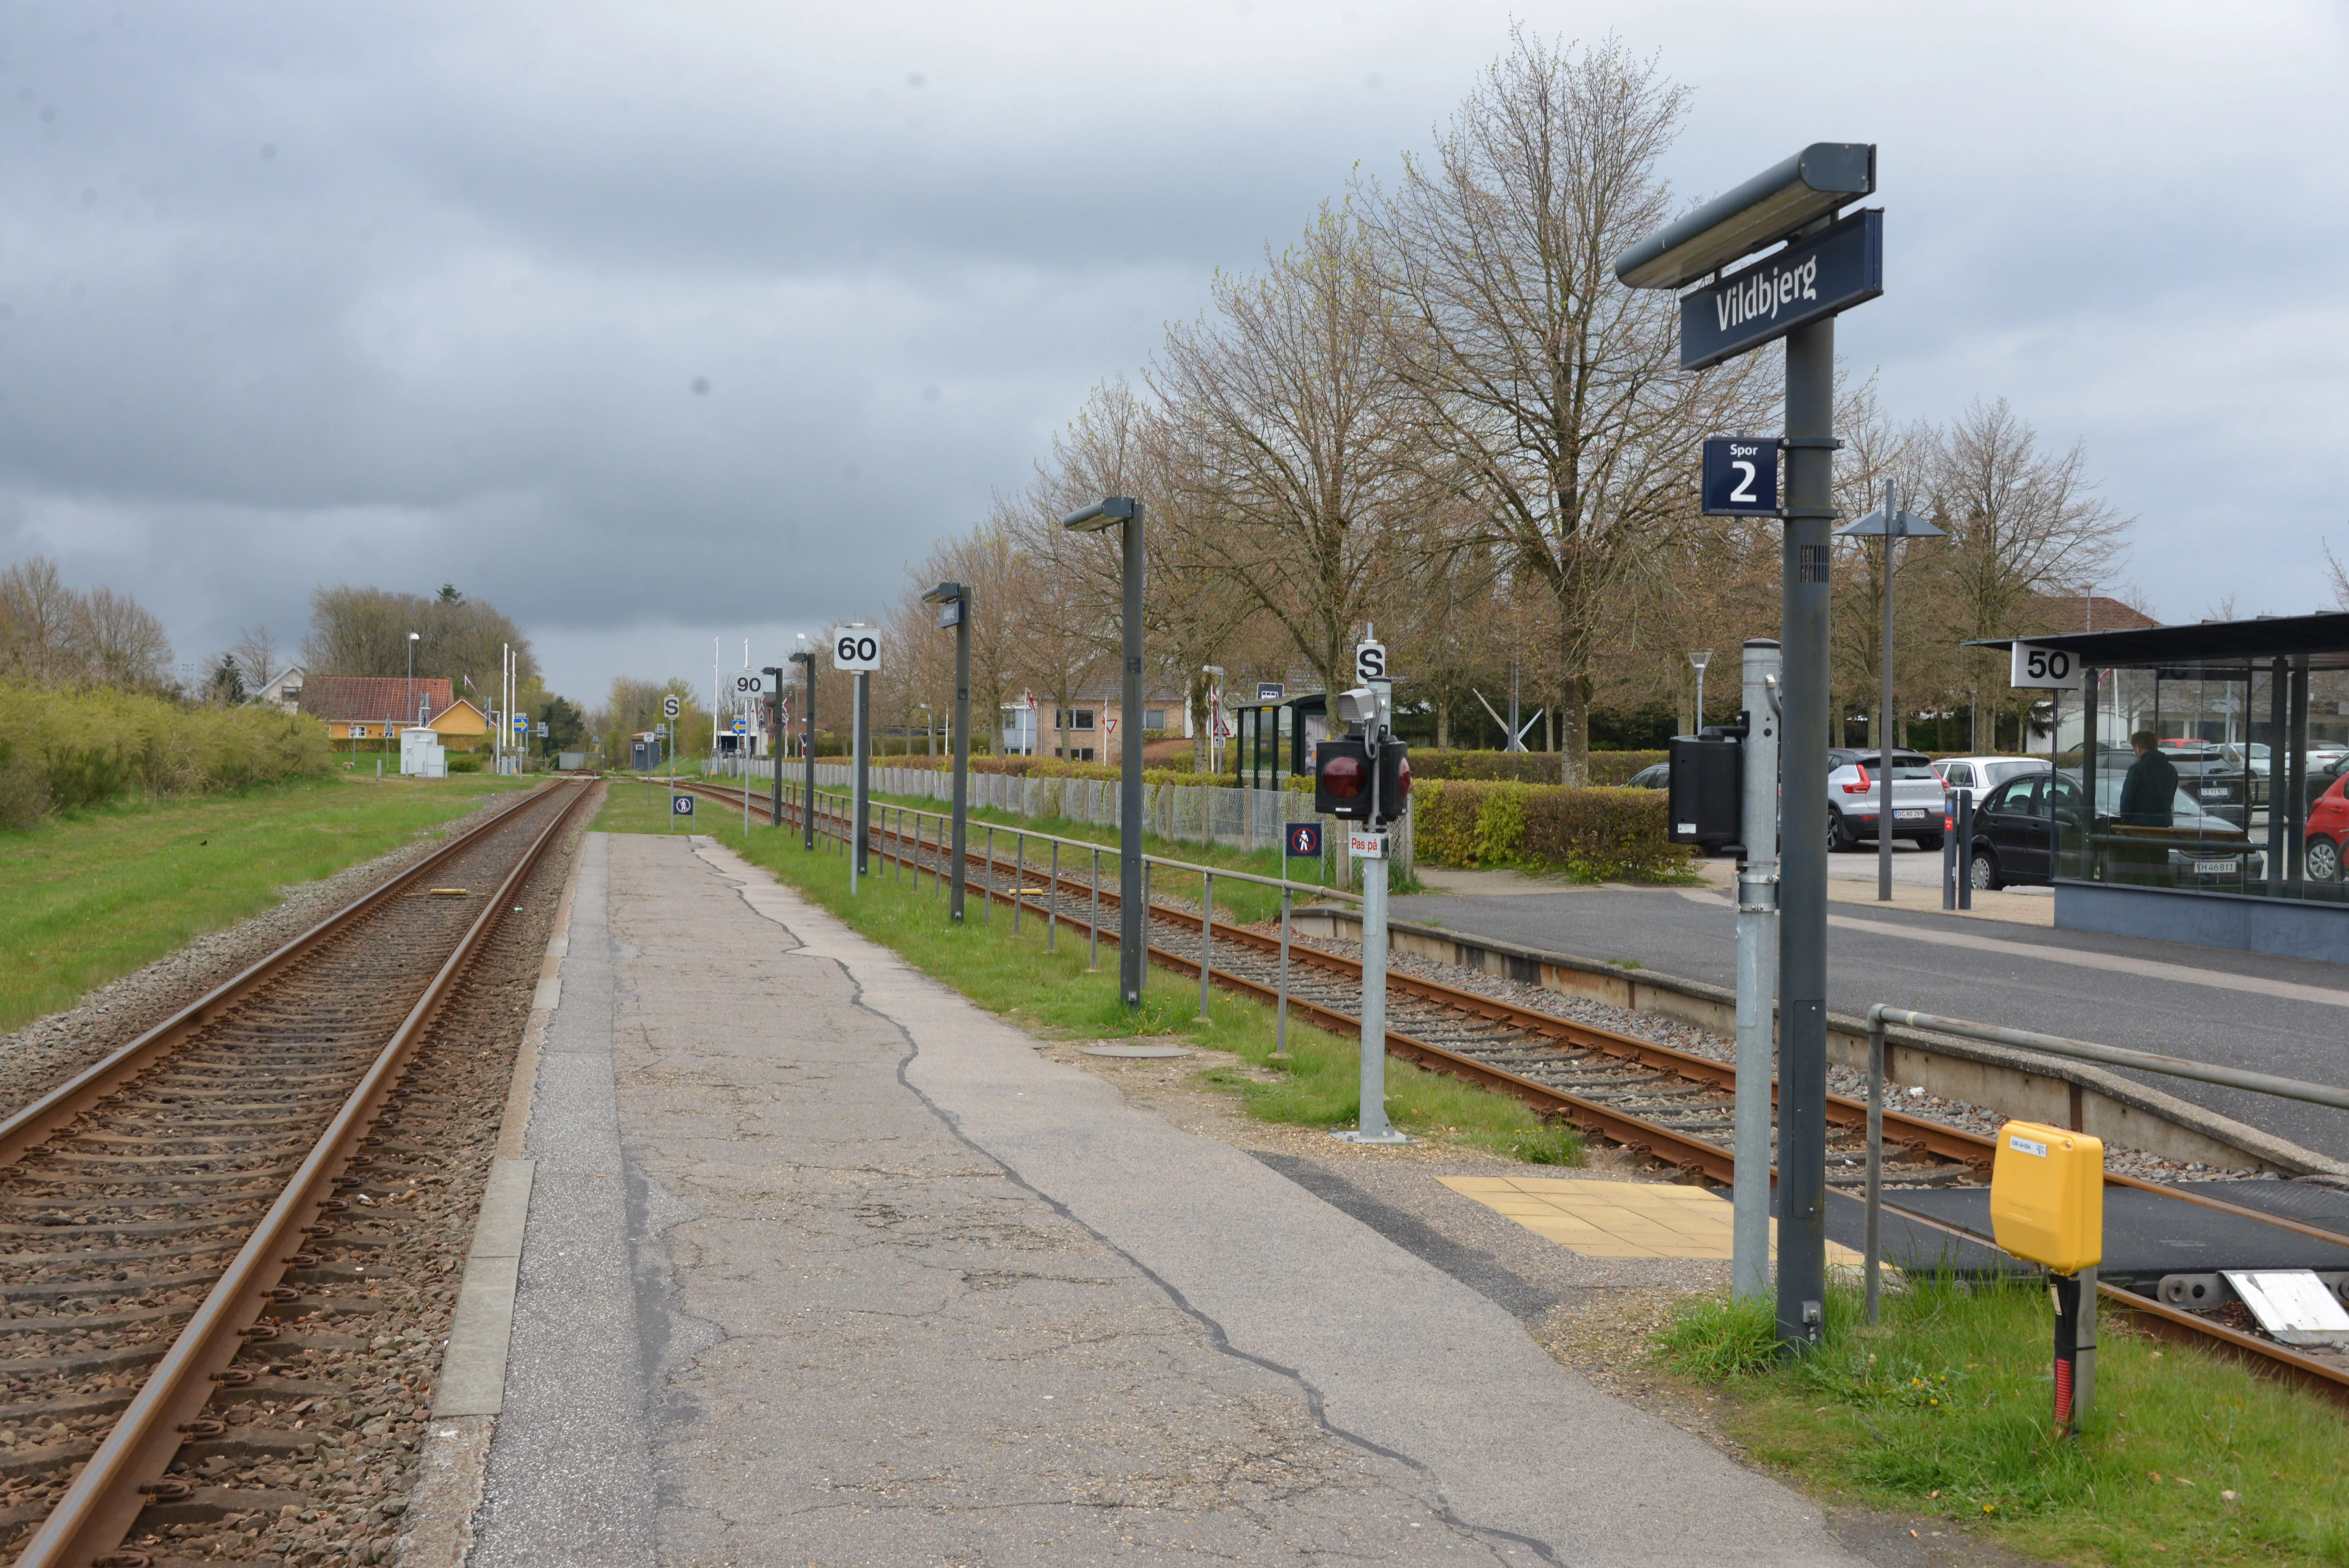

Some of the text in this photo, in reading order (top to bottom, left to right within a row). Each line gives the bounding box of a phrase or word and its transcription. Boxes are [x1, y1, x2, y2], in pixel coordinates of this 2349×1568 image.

[1716, 255, 1816, 331] Vildbjerg
[1730, 444, 1758, 457] Spor
[1730, 461, 1757, 502] 2
[838, 637, 876, 661] 60
[1358, 649, 1383, 678] S
[2027, 651, 2069, 679] 50
[737, 677, 761, 692] 90
[665, 699, 679, 715] S
[1351, 837, 1378, 852] Pas på
